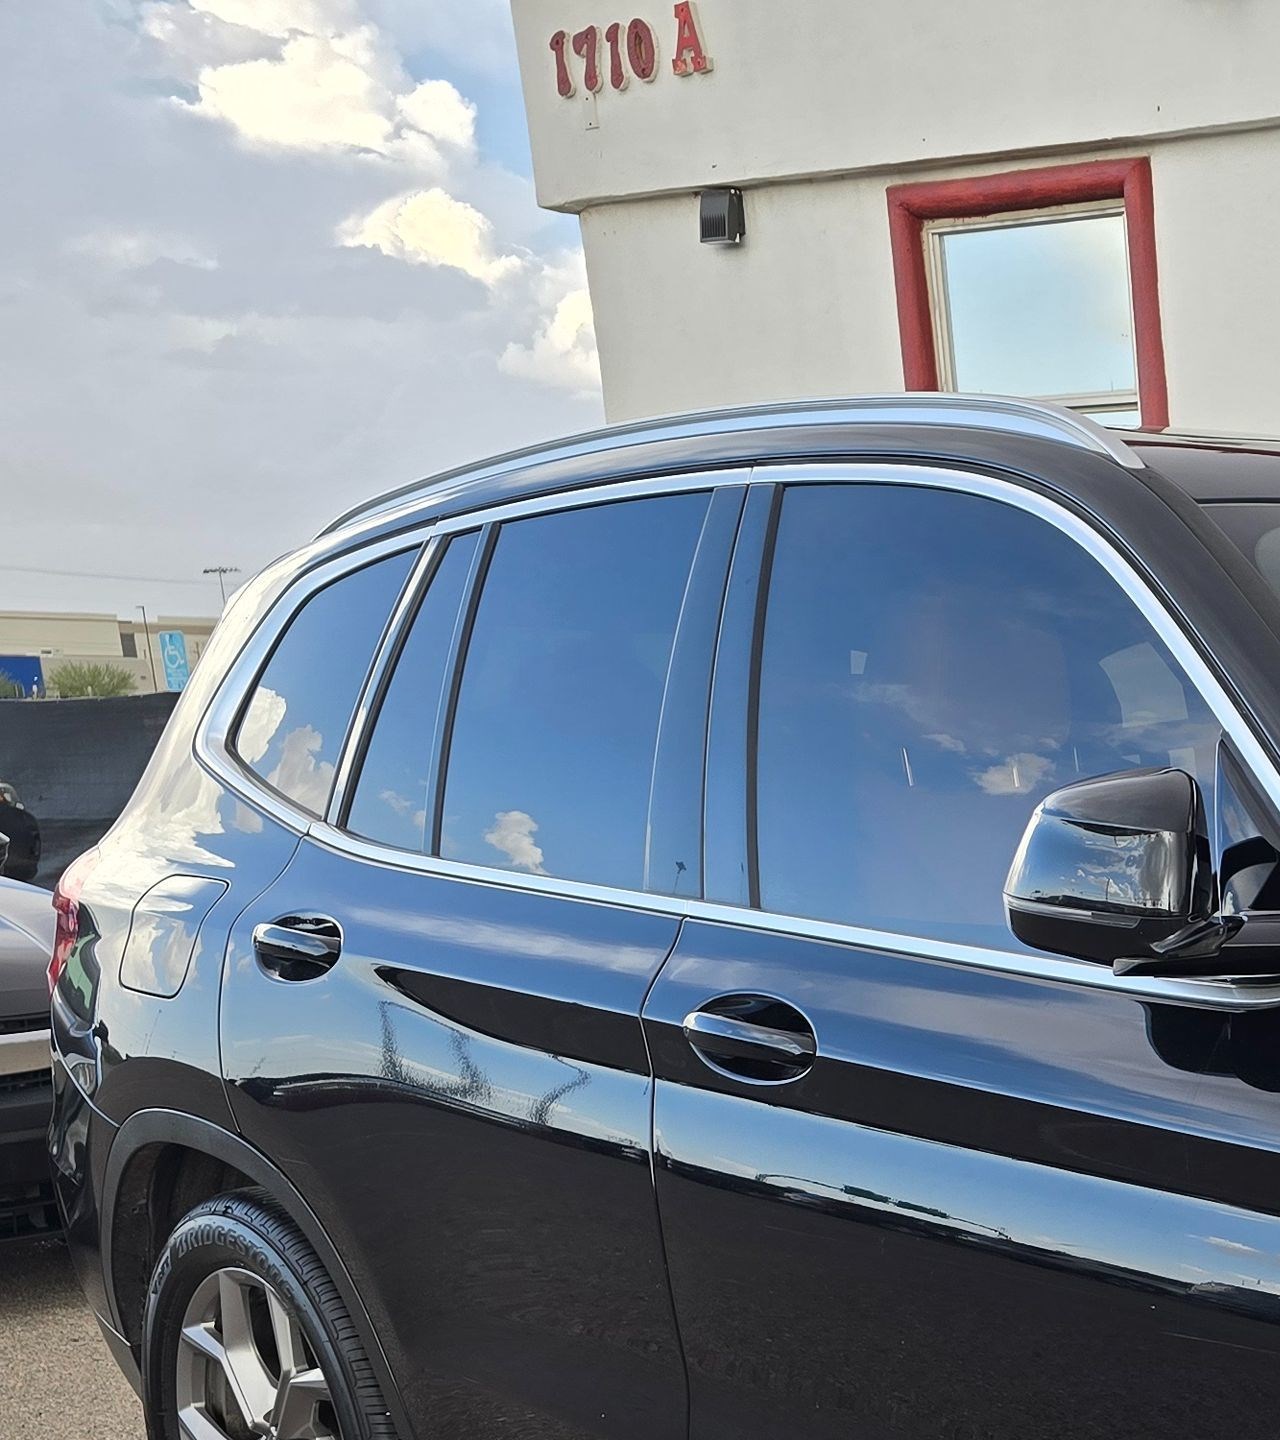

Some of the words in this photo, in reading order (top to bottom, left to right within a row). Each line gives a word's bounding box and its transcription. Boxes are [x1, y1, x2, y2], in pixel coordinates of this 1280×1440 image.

[549, 18, 656, 96] 1710
[672, 1, 709, 75] A
[174, 1223, 295, 1298] BRIDGESTONE
